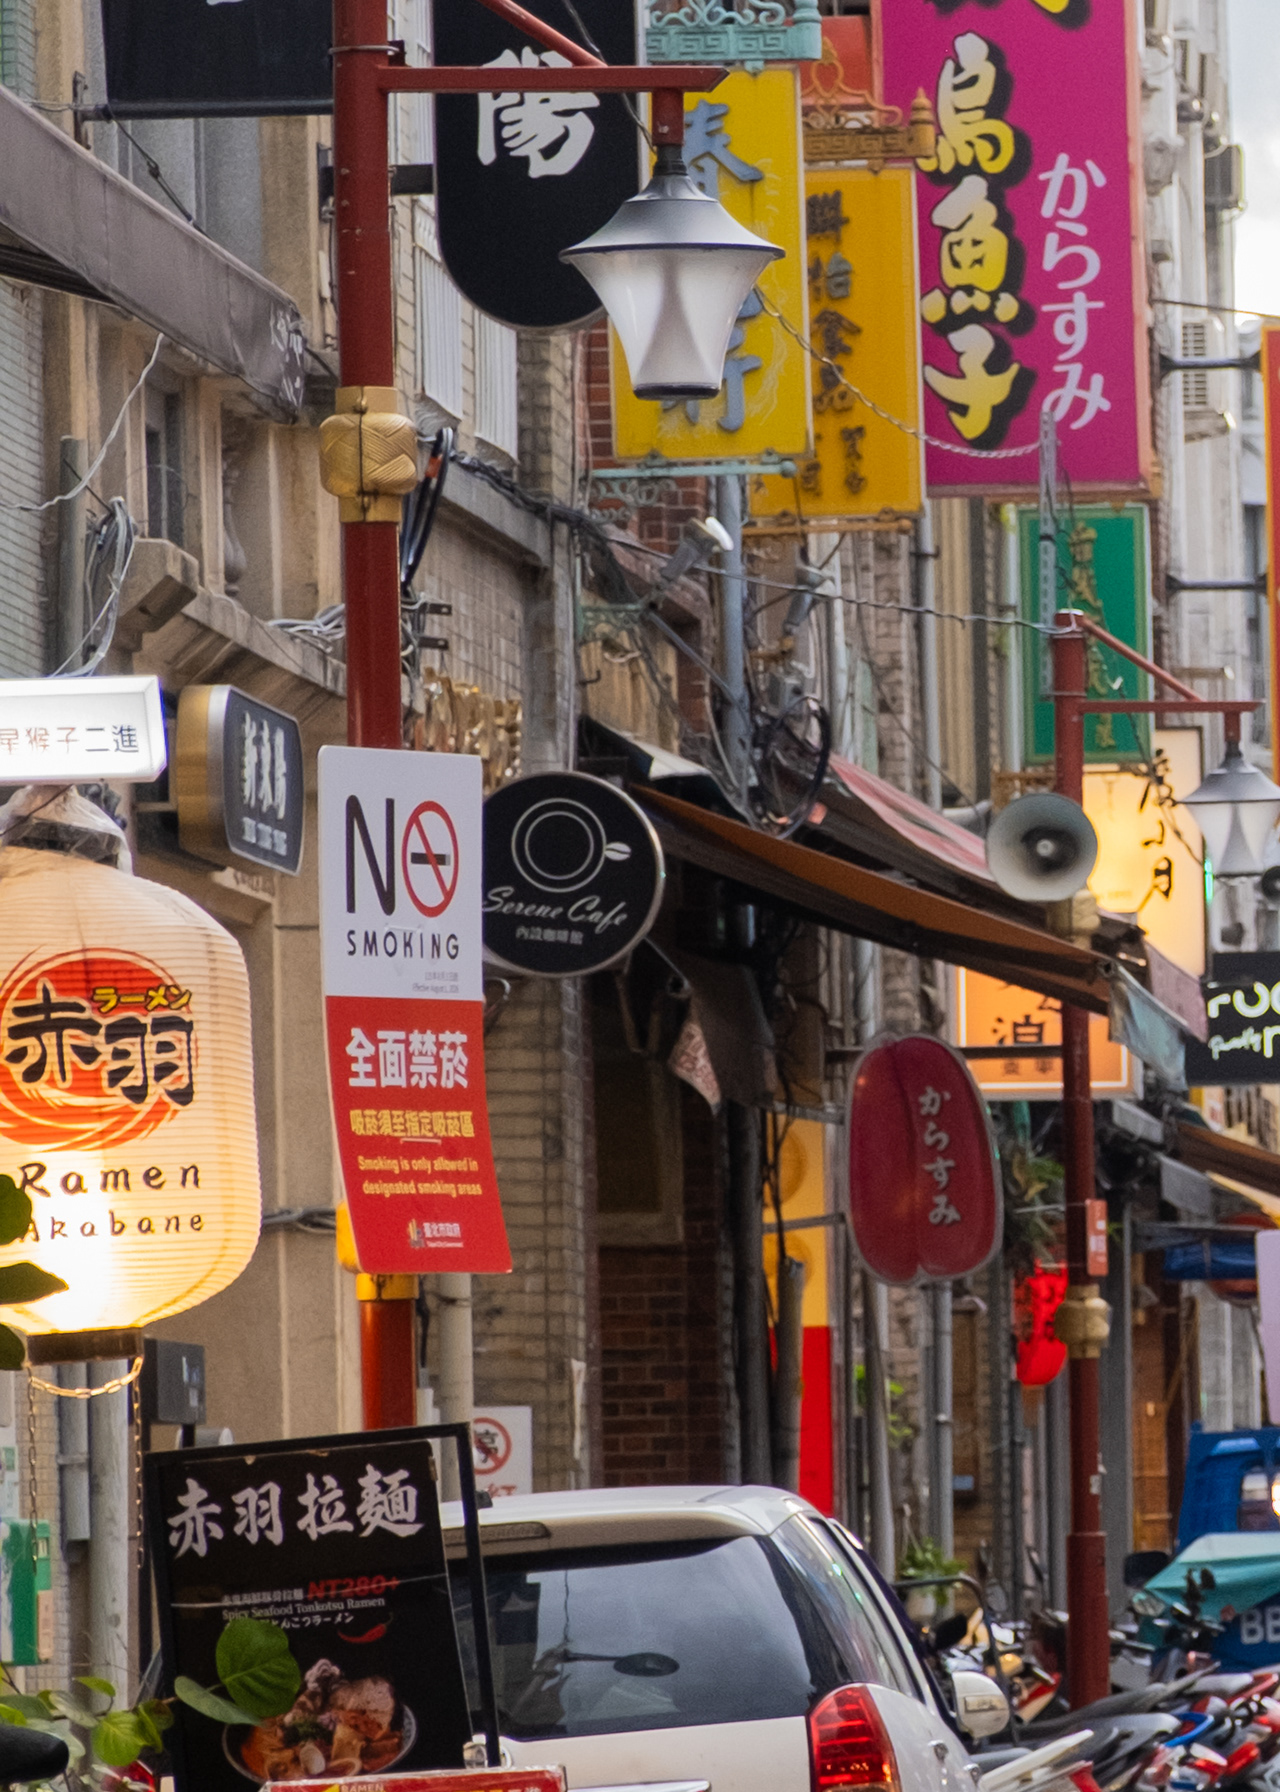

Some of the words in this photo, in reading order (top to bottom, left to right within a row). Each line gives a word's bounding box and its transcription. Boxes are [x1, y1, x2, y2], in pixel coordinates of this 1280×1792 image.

[1038, 153, 1111, 432] からすみ
[346, 929, 460, 960] SMOKING
[91, 984, 192, 1014] ラーメン
[6, 982, 194, 1107] 赤羽
[345, 1027, 469, 1089] 全面禁菸
[349, 1108, 475, 1138] 吸菸須至指定吸菸區
[358, 1156, 400, 1175] Smoking
[411, 1157, 432, 1175] only
[433, 1157, 468, 1172] allowed
[918, 1084, 962, 1226] からすみ
[18, 1162, 201, 1197] Ramen
[362, 1179, 416, 1198] designated
[417, 1180, 457, 1198] smoking
[457, 1182, 483, 1196] areas
[19, 1209, 204, 1243] Akabane
[166, 1462, 425, 1559] 赤羽拉麵
[251, 1604, 294, 1618] Seafood
[295, 1600, 346, 1614] Tonkotsu
[346, 1597, 386, 1610] Ramen
